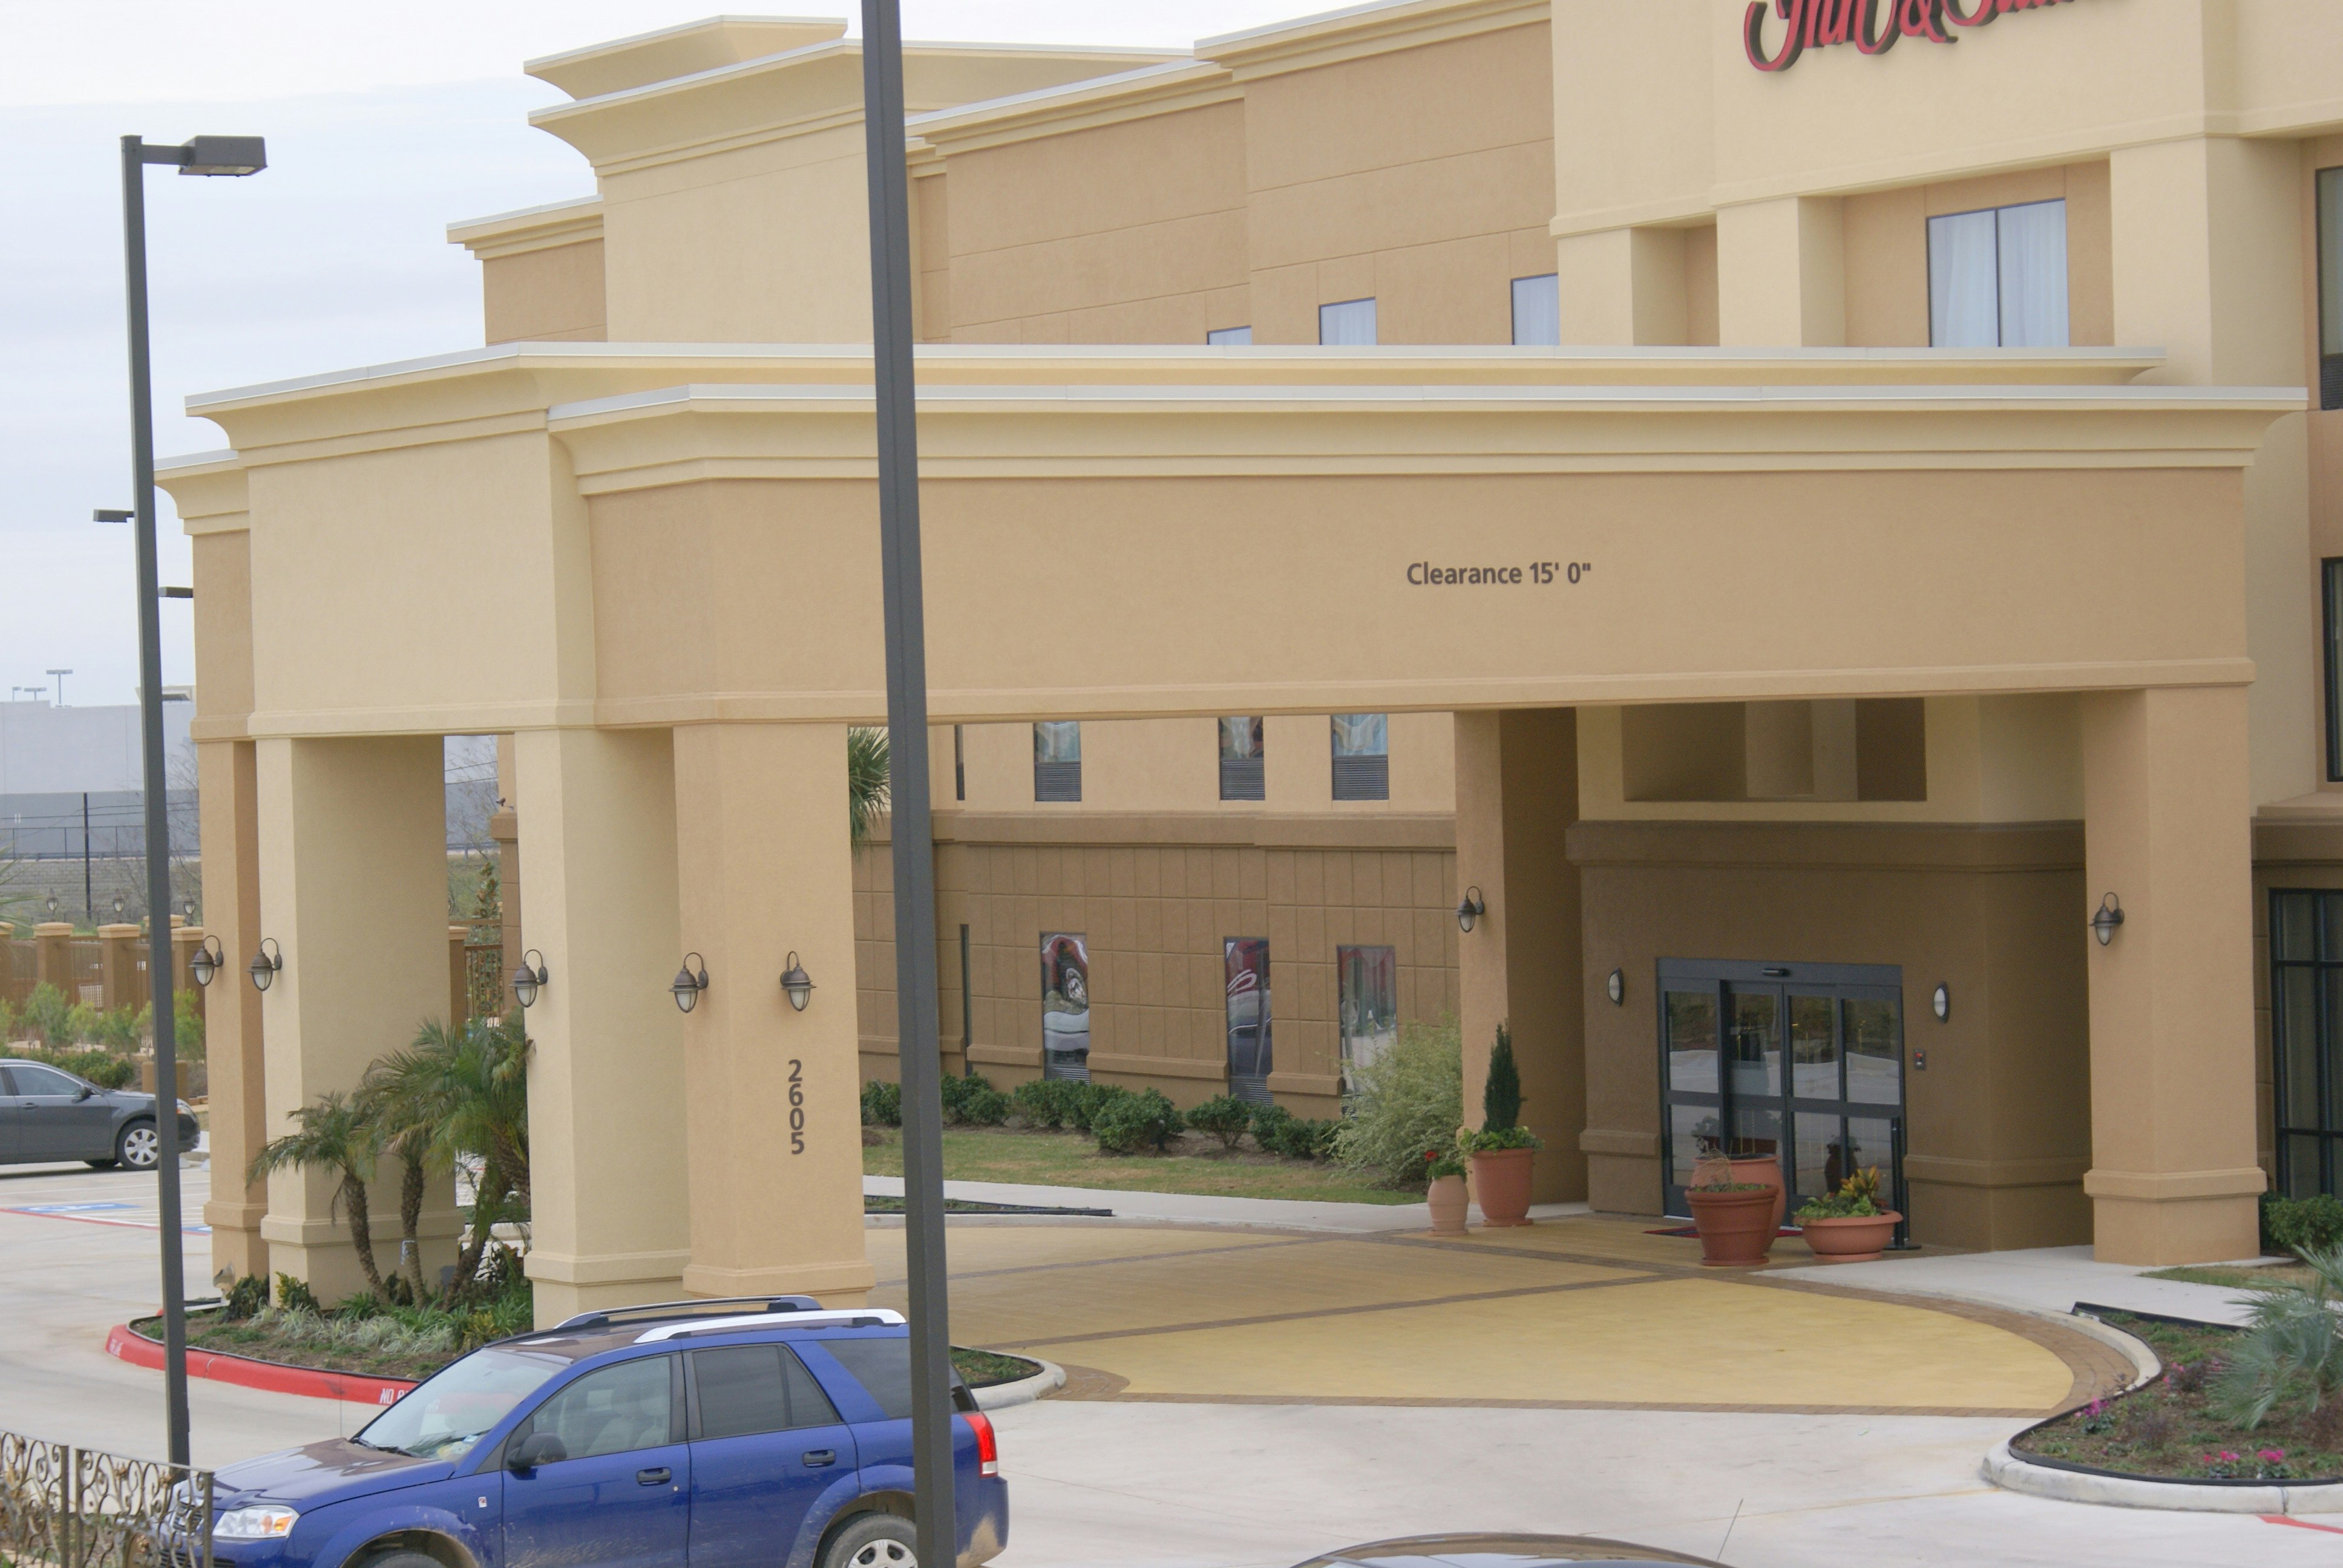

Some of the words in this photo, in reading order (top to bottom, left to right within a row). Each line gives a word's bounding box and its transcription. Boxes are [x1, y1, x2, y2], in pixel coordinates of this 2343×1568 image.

[1407, 561, 1522, 585] Clearance
[1529, 562, 1559, 584] 15'
[788, 1059, 805, 1155] 2605
[379, 1388, 395, 1405] NO
